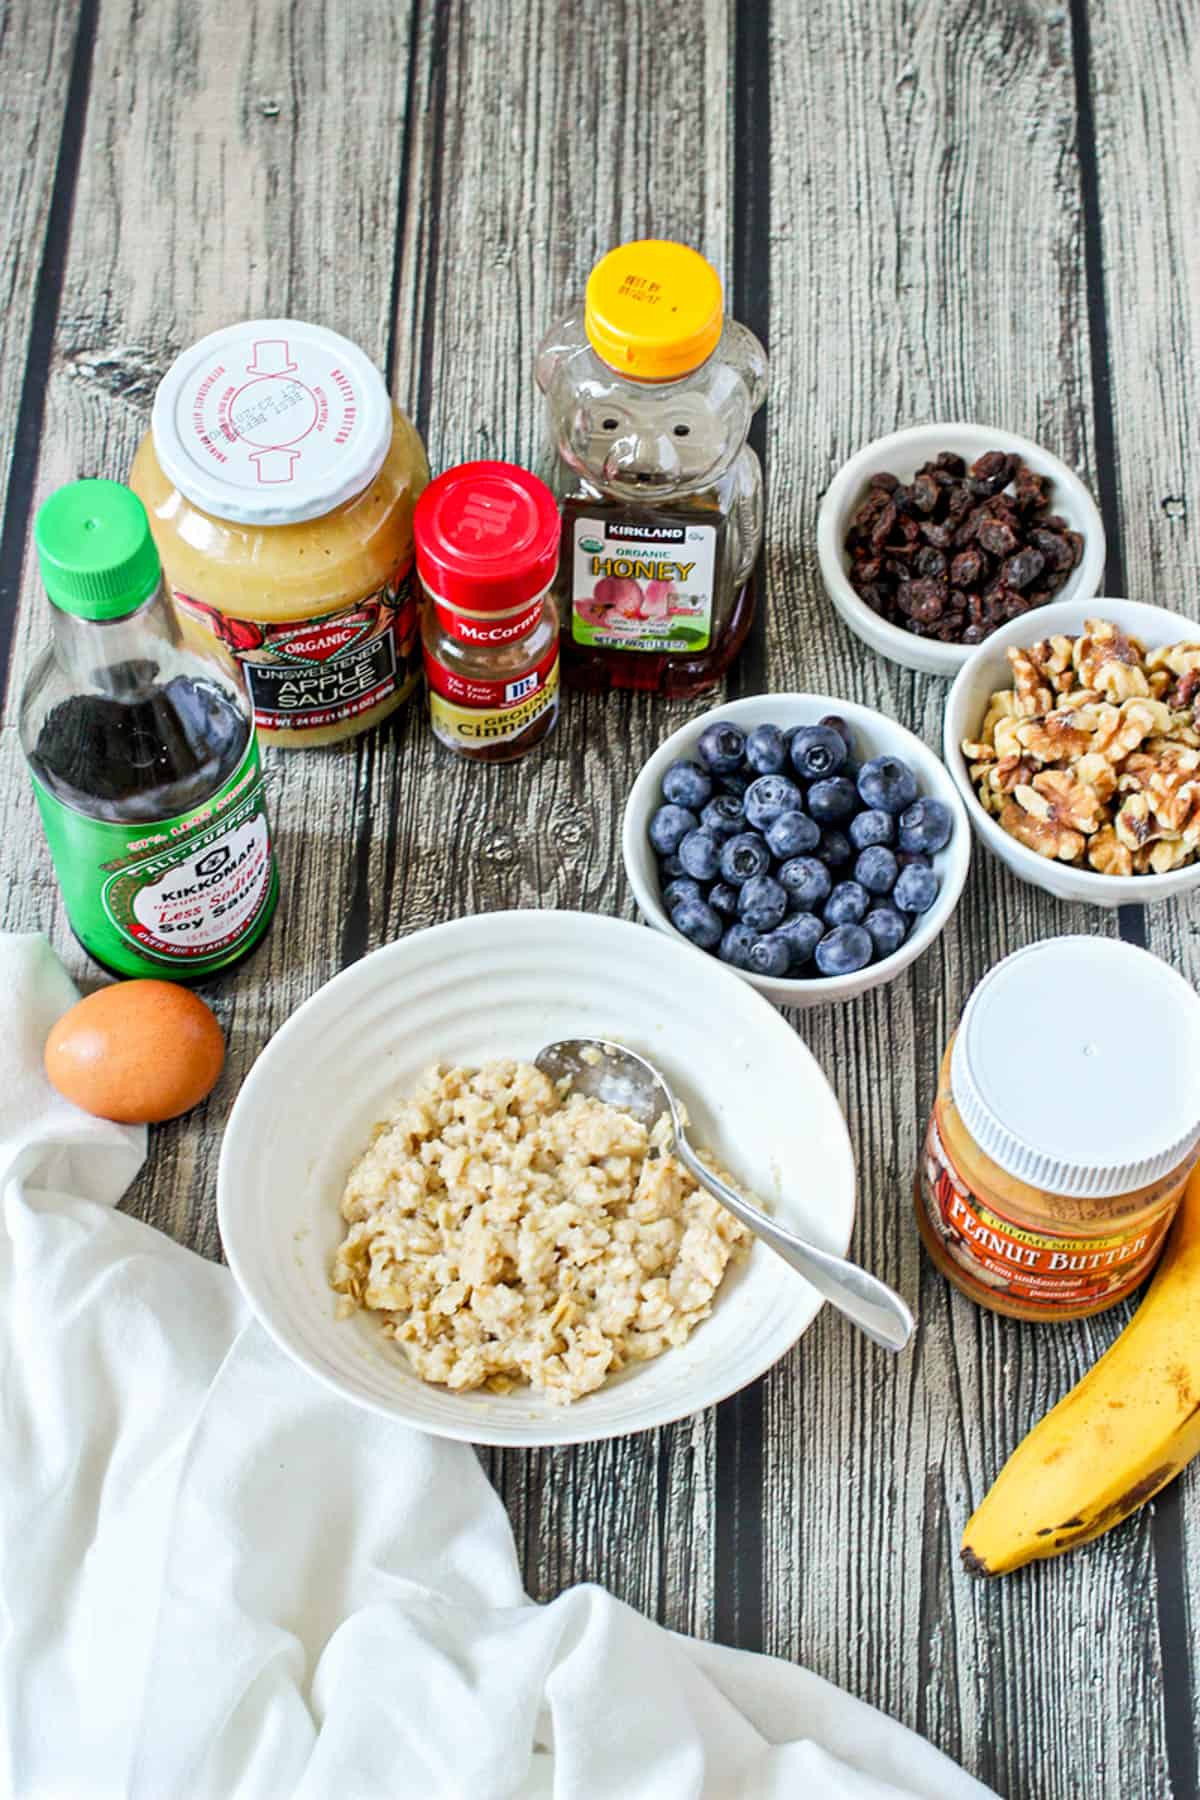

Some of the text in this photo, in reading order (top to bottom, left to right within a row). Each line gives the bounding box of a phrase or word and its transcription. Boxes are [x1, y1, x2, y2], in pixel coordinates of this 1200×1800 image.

[609, 524, 682, 538] KIRKLAND
[616, 548, 671, 558] ORGANIC
[591, 556, 696, 581] HONEY
[284, 630, 351, 654] ORGANIC
[257, 641, 384, 680] UNSWEETENED
[279, 658, 376, 695] APPLE
[448, 677, 491, 694] The Taste
[278, 673, 377, 708] SAUCE
[448, 685, 464, 696] You
[161, 838, 255, 902] KIKKOMAN
[159, 917, 204, 934] Soy
[212, 861, 265, 918] Sauce
[159, 906, 201, 923] Less
[192, 939, 228, 953] YEARS
[950, 1197, 1040, 1268] PEANUT
[1048, 1234, 1148, 1272] BUTTER
[984, 1258, 1012, 1279] from
